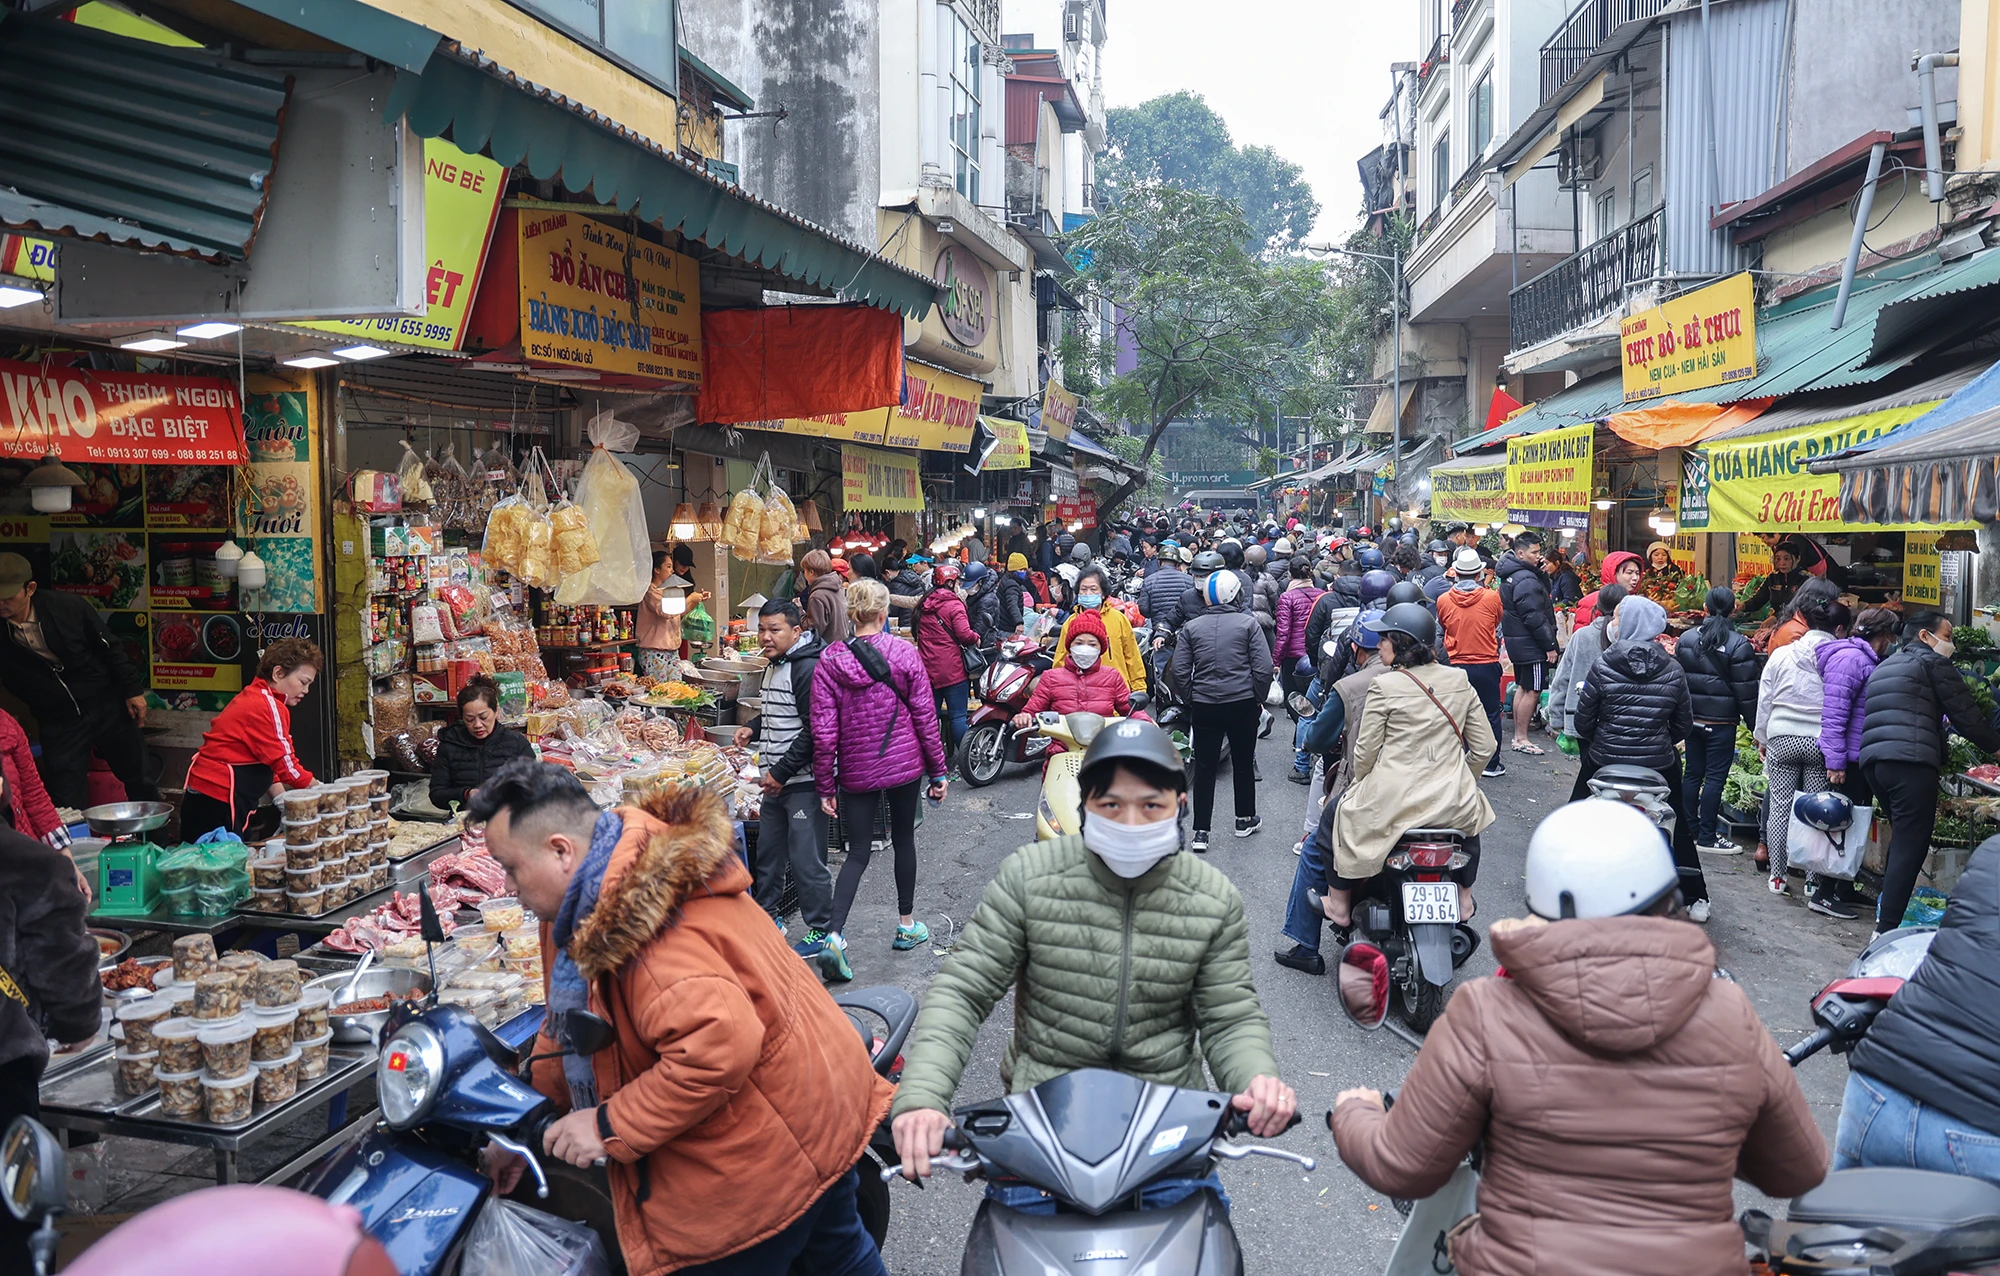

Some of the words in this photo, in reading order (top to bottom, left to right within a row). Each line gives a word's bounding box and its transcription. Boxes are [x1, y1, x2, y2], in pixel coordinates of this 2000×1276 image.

[424, 158, 457, 184] NG
[460, 169, 485, 194] BÈ
[550, 239, 576, 287] ĐỒ
[577, 253, 602, 294] ĂN
[603, 269, 640, 303] CH
[400, 319, 422, 336] 655
[423, 325, 453, 342] 9995
[528, 291, 569, 337] HÀNG
[570, 304, 599, 342] KHÔ
[600, 309, 626, 353] ĐẶC
[1626, 336, 1655, 369] THỊT
[1657, 321, 1676, 358] BÒ
[1704, 307, 1743, 344] THUI
[1649, 368, 1662, 382] NEM
[1663, 363, 1676, 379] CUA
[1681, 358, 1695, 374] NEM
[1697, 350, 1709, 371] HẢI
[1712, 345, 1726, 367] SẢN
[1, 371, 97, 439] KHO
[101, 382, 170, 406] THƠM
[176, 386, 236, 409] NGON
[109, 409, 157, 442] ĐẶC
[161, 415, 209, 443] BIỆT
[243, 417, 307, 443] Luôn
[87, 446, 105, 458] Tel:
[107, 447, 131, 459] 0913
[133, 448, 149, 460] 307
[151, 449, 169, 460] 699
[177, 449, 194, 461] 088
[195, 449, 207, 461] 88
[209, 450, 225, 461] 251
[227, 450, 238, 461] 88
[1171, 472, 1230, 483] H.promart
[1758, 492, 1773, 524] 3
[249, 510, 304, 535] Tươi
[1910, 563, 1922, 577] NEM
[1923, 564, 1936, 581] THỊT
[1411, 886, 1450, 903] 29-D2
[1408, 904, 1455, 920] 379.64
[1073, 1249, 1129, 1262] HONDA
